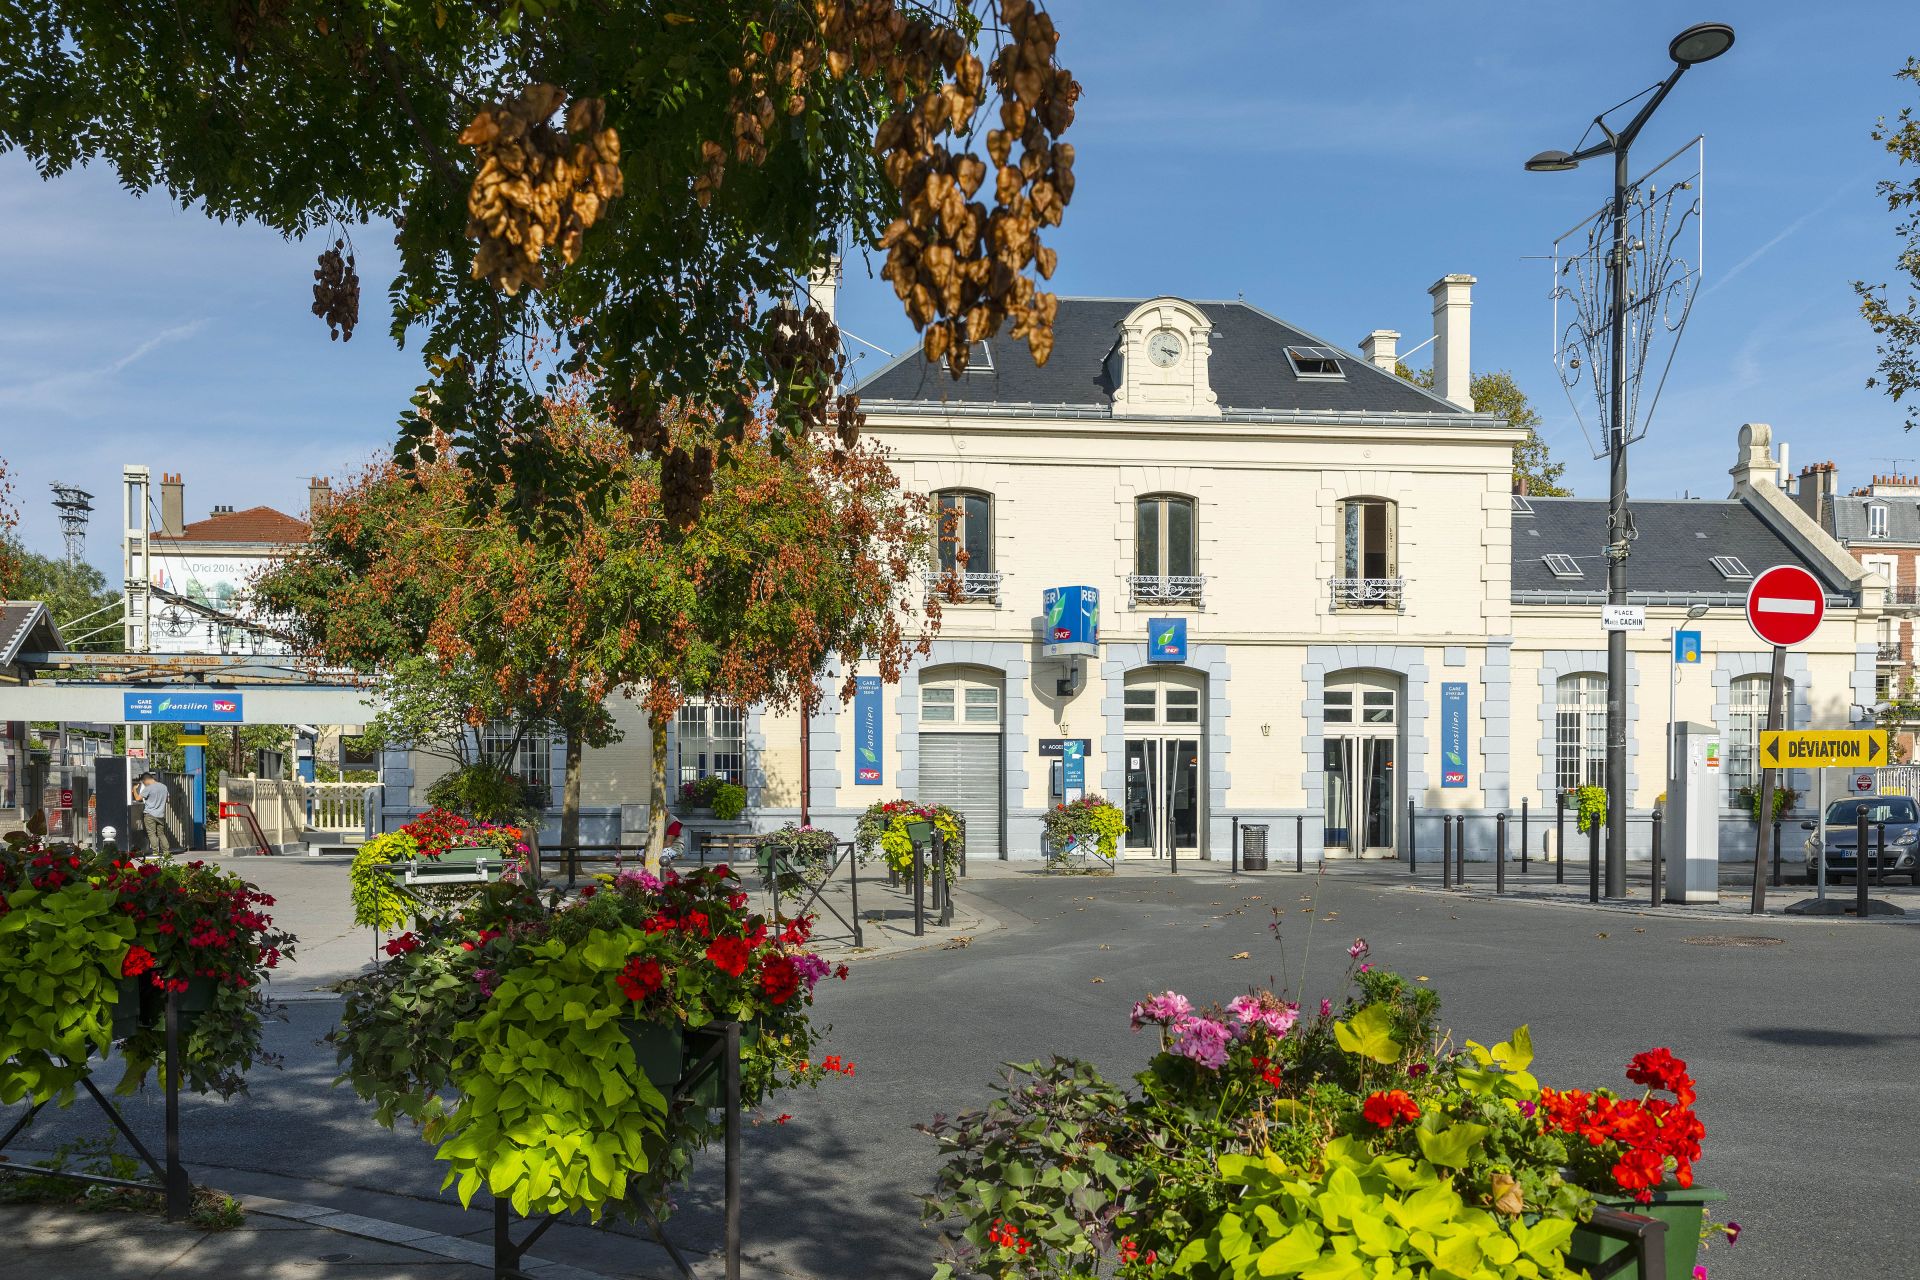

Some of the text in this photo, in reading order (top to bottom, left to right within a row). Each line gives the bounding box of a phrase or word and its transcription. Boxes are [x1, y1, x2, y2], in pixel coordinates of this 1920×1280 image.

[213, 563, 235, 573] 2016
[1082, 590, 1097, 603] RER
[1620, 618, 1643, 626] CACHIN
[1054, 631, 1070, 639] SNCF
[214, 703, 236, 711] SNCF
[1788, 737, 1860, 758] DÉVIATION
[860, 772, 880, 780] SNCF
[1446, 774, 1464, 782] SNCF
